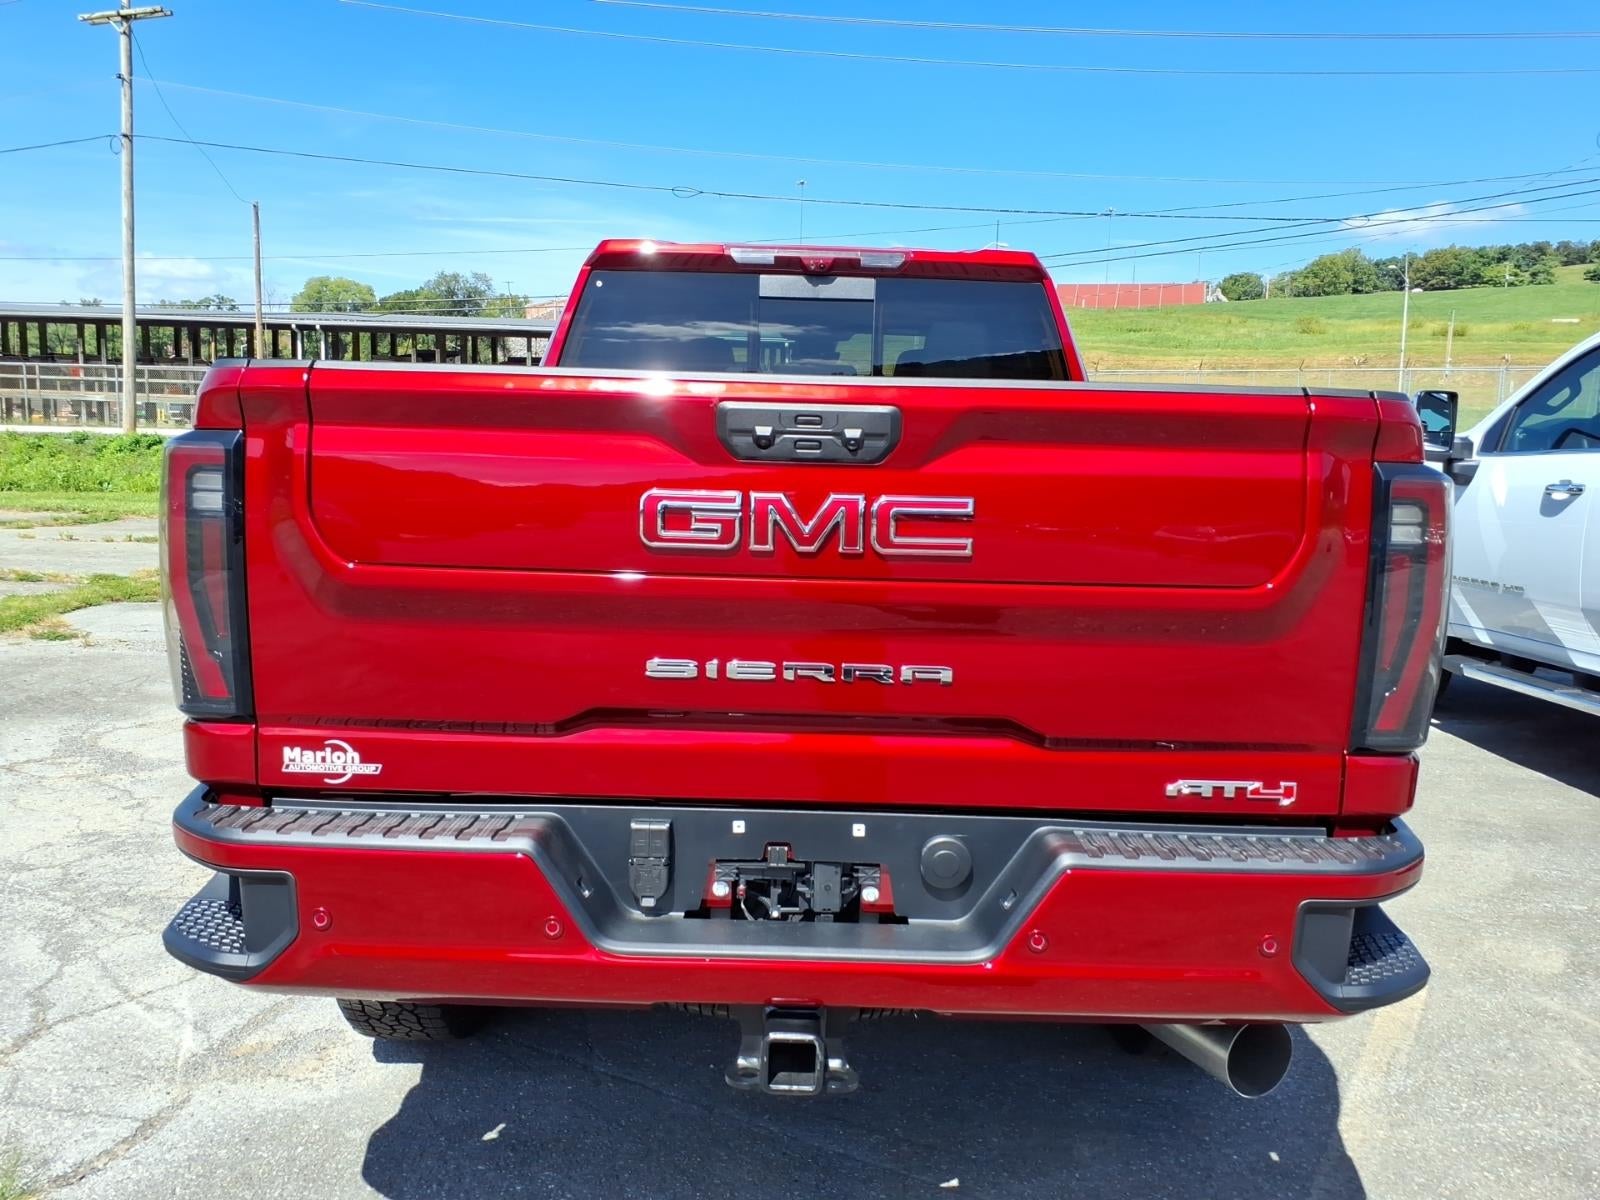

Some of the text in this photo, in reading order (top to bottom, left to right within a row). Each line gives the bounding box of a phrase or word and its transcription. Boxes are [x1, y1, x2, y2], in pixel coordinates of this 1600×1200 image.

[639, 487, 975, 557] GMC
[645, 656, 955, 685] SIERRA
[282, 746, 360, 764] Marion
[288, 764, 377, 773] AUTOMOTIVE GROUP
[1165, 779, 1297, 806] AT4
